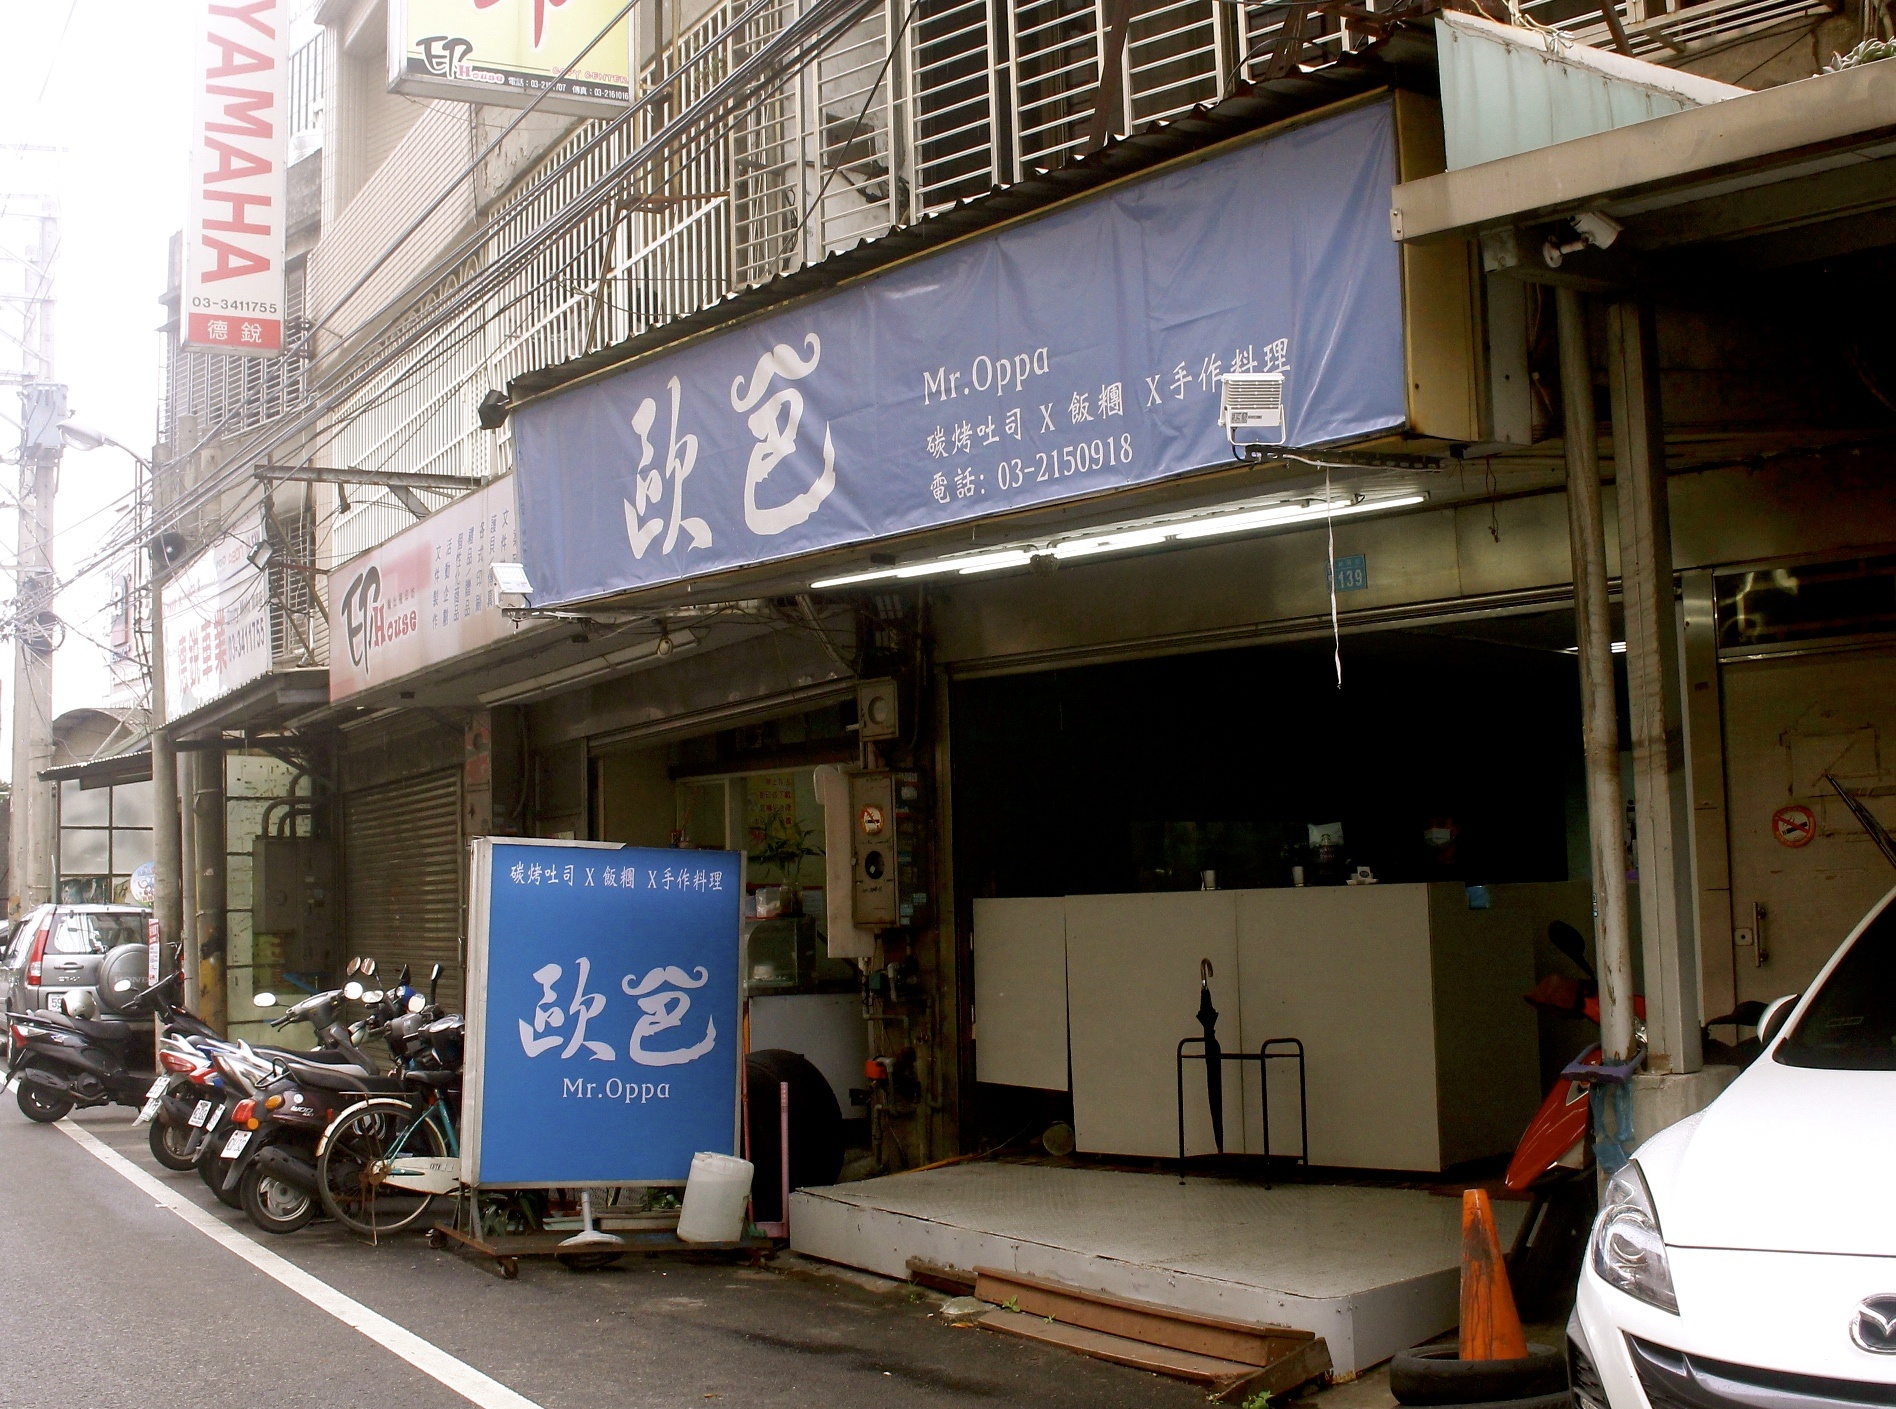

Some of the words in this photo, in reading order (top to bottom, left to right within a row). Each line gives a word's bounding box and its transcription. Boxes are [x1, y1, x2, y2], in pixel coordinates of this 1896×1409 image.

[200, 0, 277, 284] YAMAHA
[192, 296, 277, 314] 03-3411755
[207, 319, 262, 344] 德銳
[923, 346, 1050, 405] Mr.Oppa
[926, 407, 1022, 459] 碳烤吐司
[1067, 382, 1124, 423] 飯糰
[997, 432, 1134, 491] 03-2150918
[1338, 569, 1363, 588] 139
[228, 617, 265, 663] 03-3411755
[373, 602, 417, 648] House
[510, 860, 574, 887] 碳烤吐司
[562, 1077, 670, 1104] Mr.Oppa
